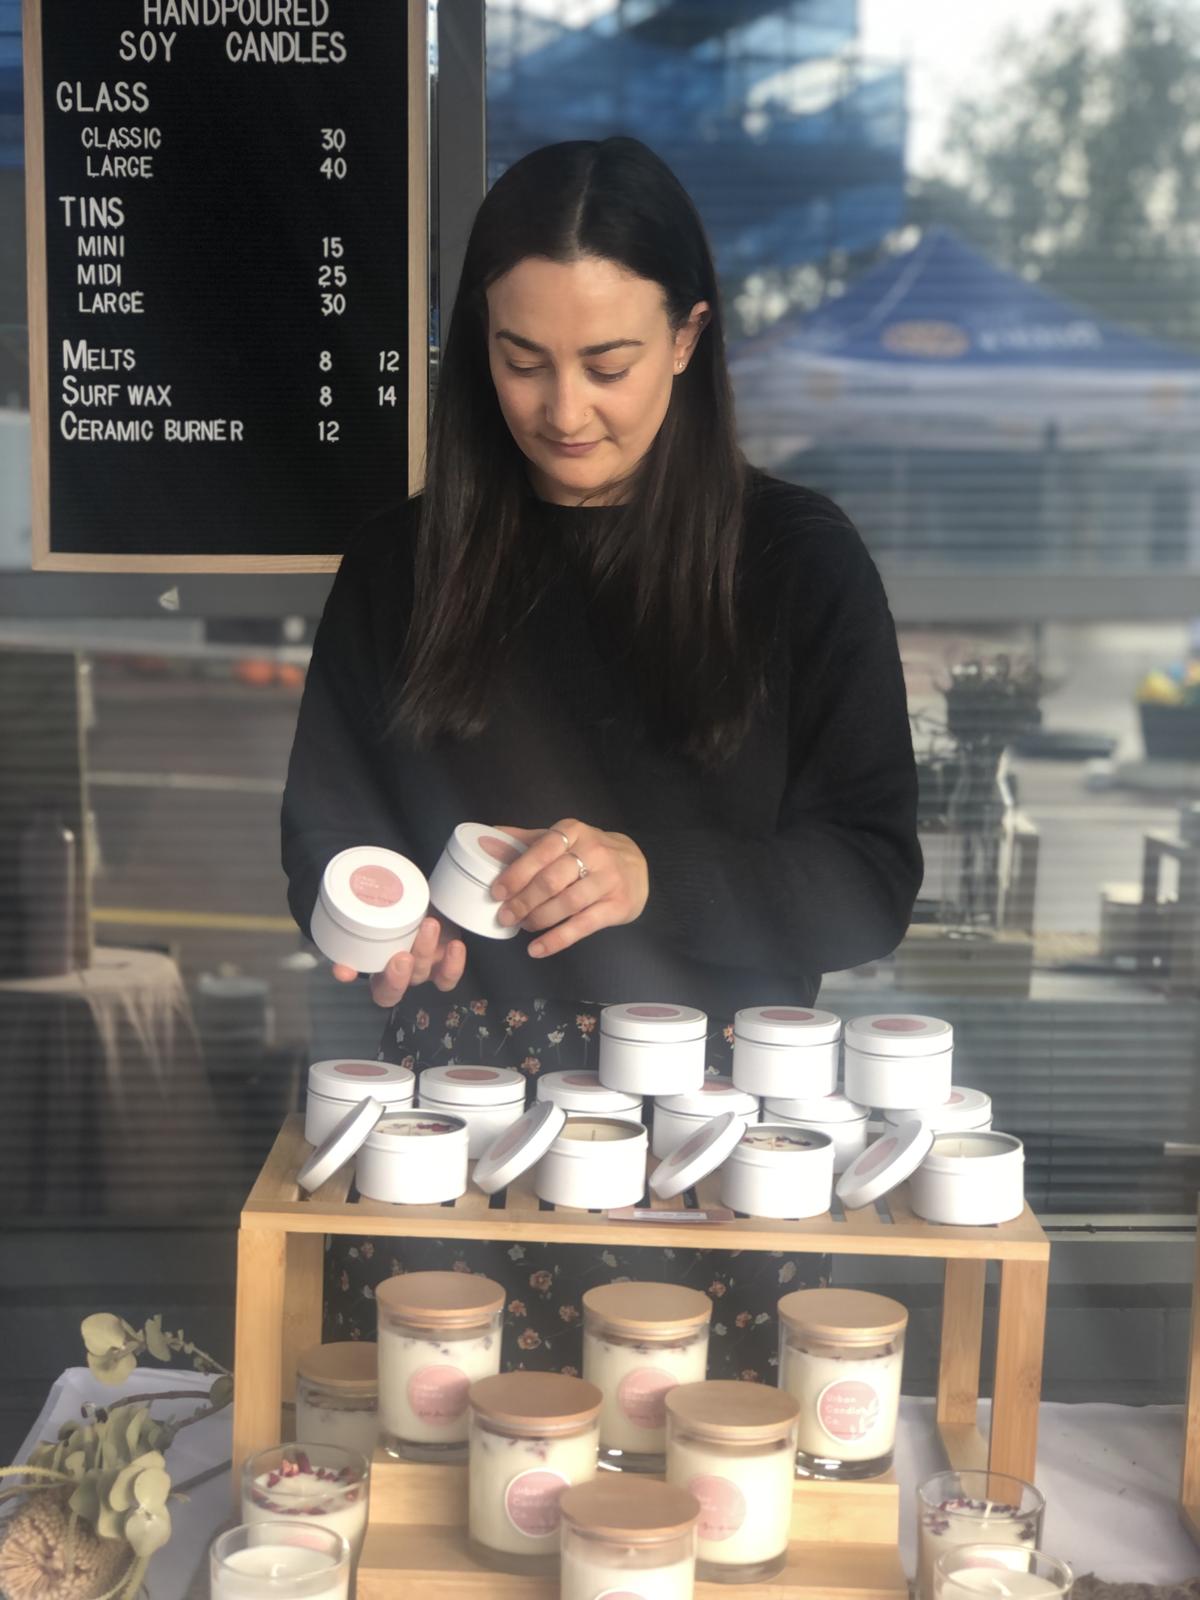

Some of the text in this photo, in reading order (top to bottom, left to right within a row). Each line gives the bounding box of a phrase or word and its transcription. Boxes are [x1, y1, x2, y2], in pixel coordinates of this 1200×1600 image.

[143, 0, 329, 27] HANDPOURED
[119, 31, 347, 64] SOY CANDLES
[56, 81, 150, 113] GLASS
[81, 127, 346, 153] CLASSIC 30
[86, 155, 347, 180] LARGE 40
[59, 195, 125, 229] TINS
[77, 235, 344, 259] MINI 15
[77, 263, 347, 288] MIDI 25
[78, 291, 346, 317] LARGE 30
[319, 351, 333, 372] 8
[379, 350, 400, 372] 12
[127, 384, 172, 407] WAX
[319, 385, 333, 408] 8
[378, 385, 397, 407] 14
[165, 418, 244, 443] BURNER
[318, 420, 340, 443] 12
